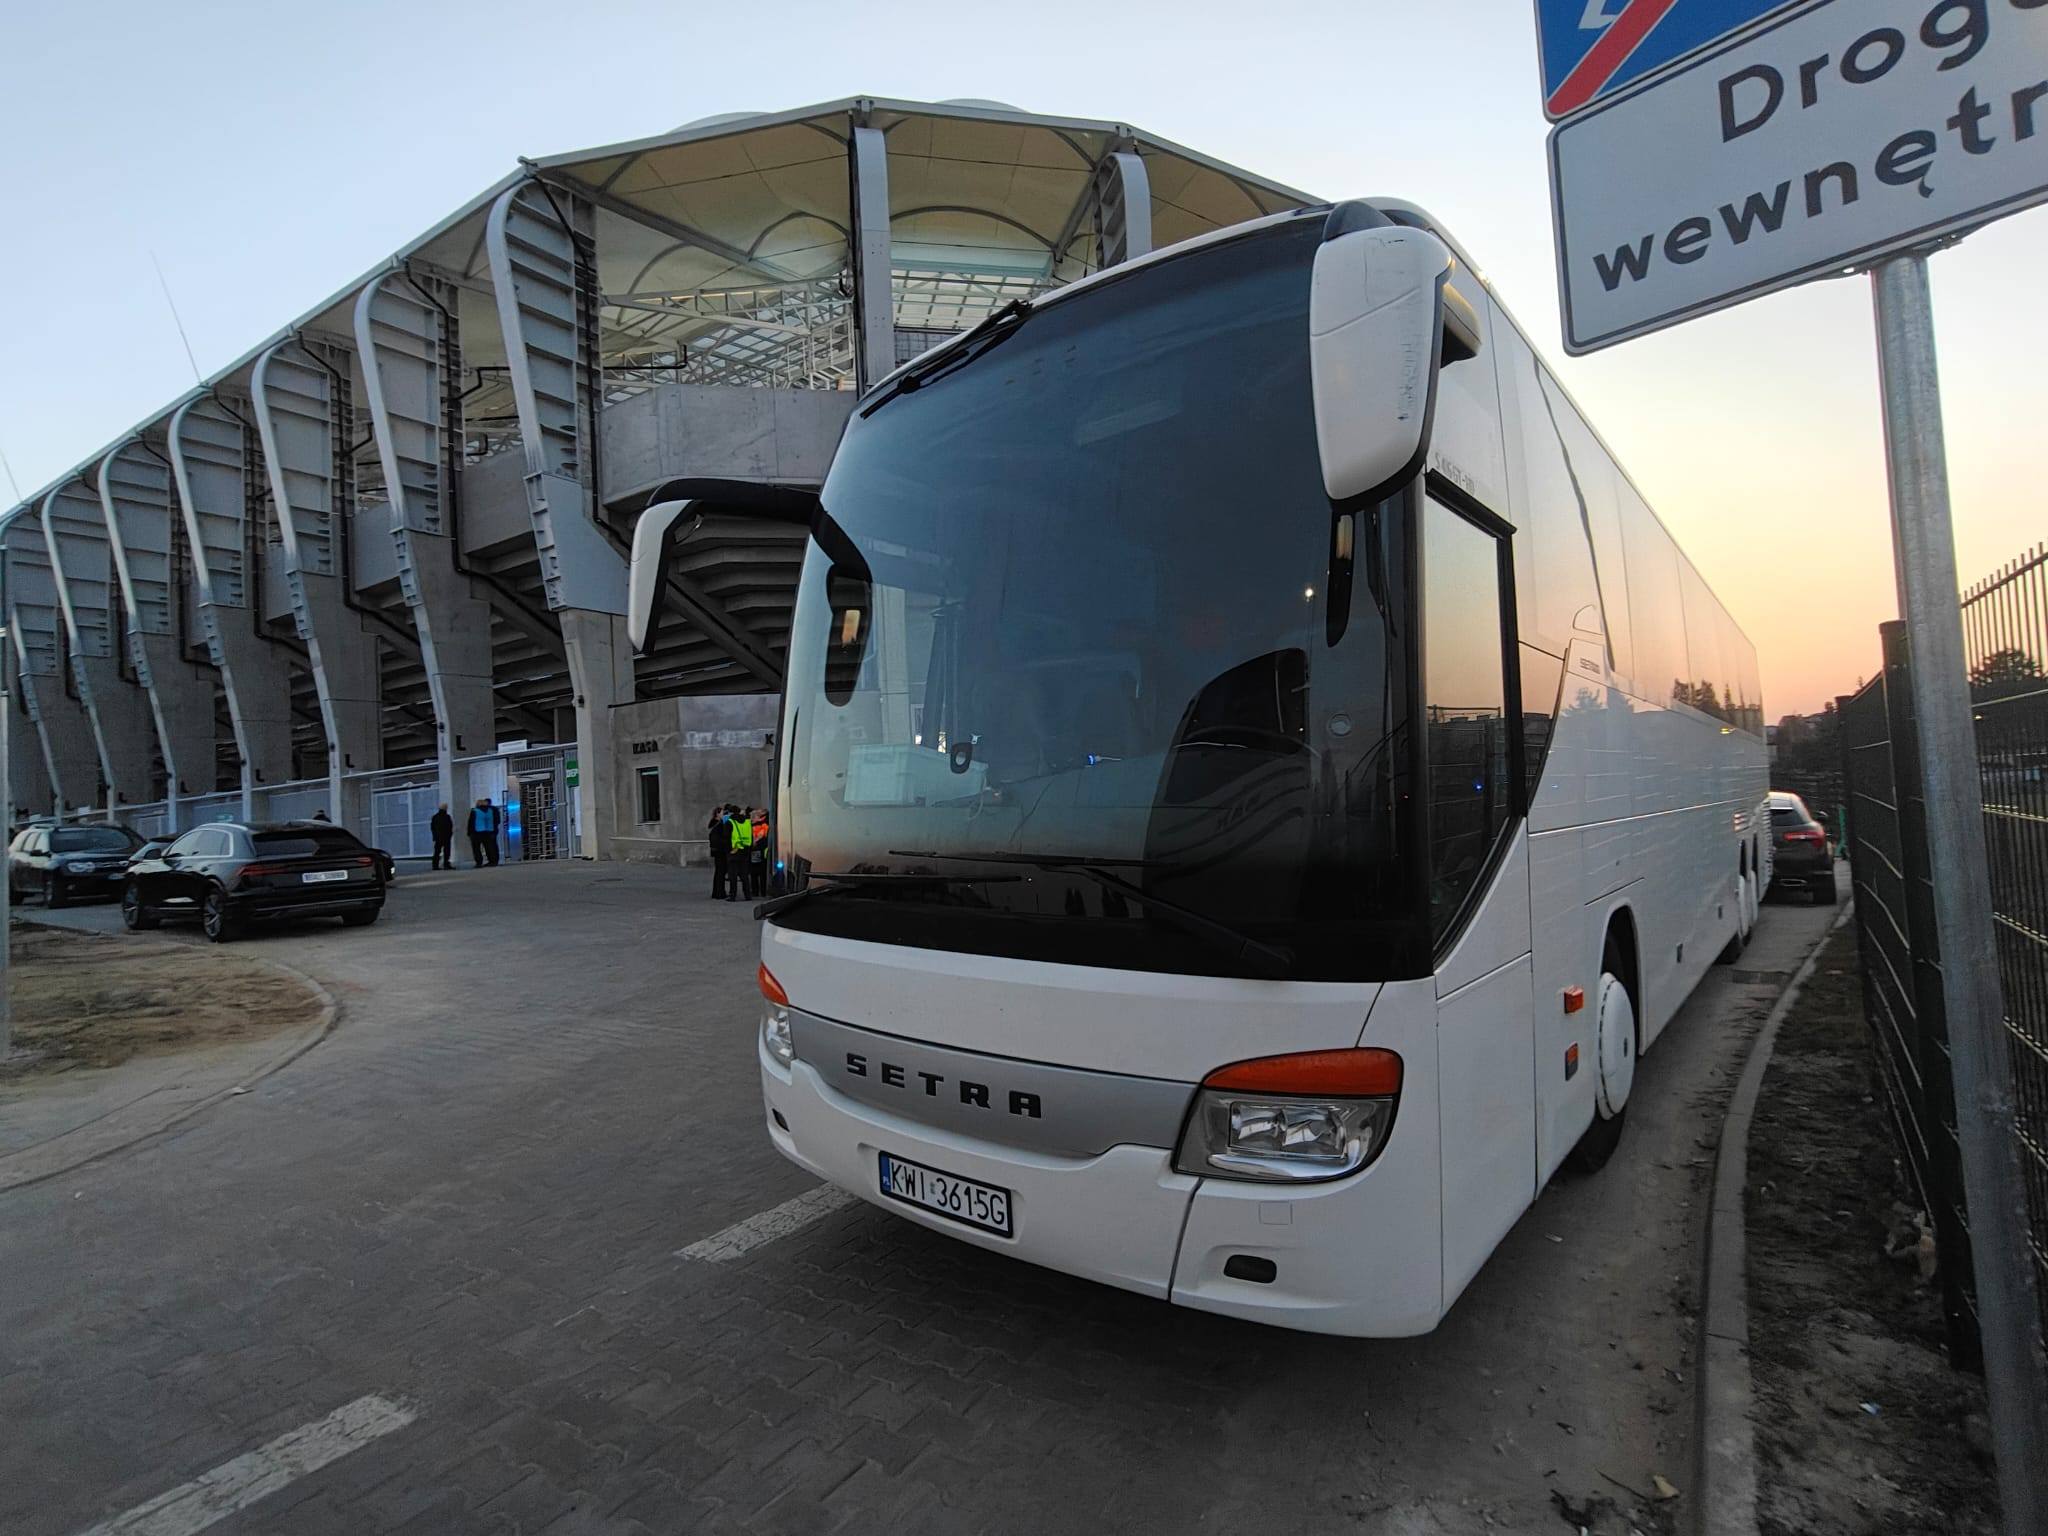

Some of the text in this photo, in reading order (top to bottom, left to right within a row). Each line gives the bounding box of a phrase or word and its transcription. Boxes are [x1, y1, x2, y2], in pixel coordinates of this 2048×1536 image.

[1718, 0, 2048, 143] Drog
[846, 1052, 1043, 1119] SETRA
[891, 1161, 1005, 1225] KWI 3615G
